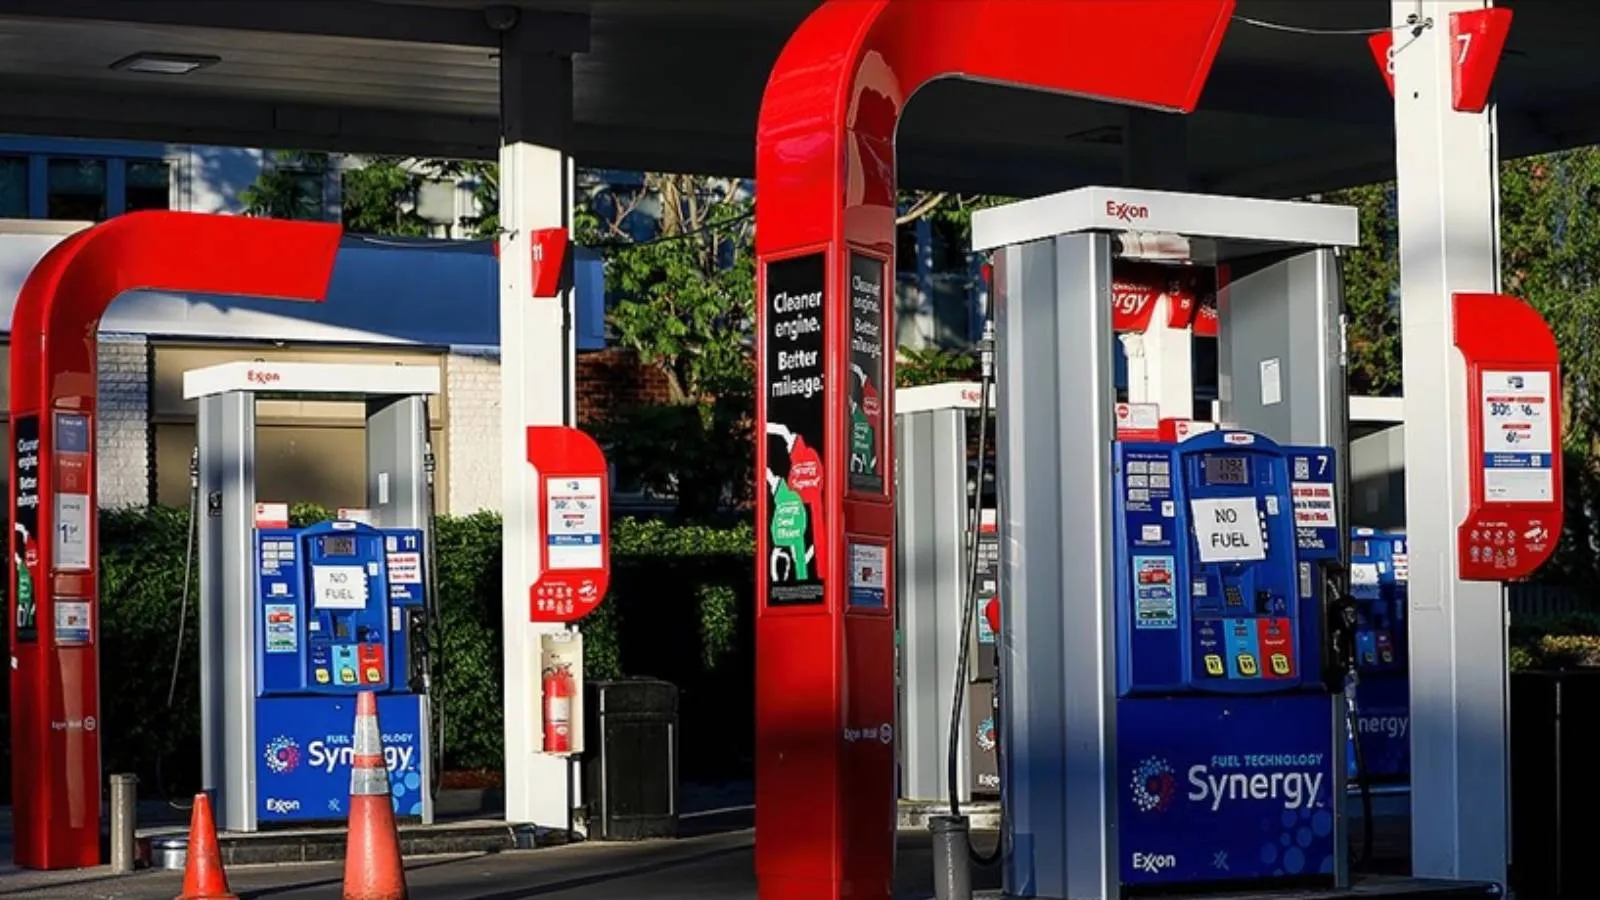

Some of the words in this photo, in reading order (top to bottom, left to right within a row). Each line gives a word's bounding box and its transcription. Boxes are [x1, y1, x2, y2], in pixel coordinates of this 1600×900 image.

[1457, 33, 1472, 64] 7
[1106, 200, 1148, 221] Exxon
[533, 243, 542, 261] 11
[774, 291, 822, 314] Cleaner
[775, 313, 821, 341] engine.
[777, 349, 818, 371] Better
[247, 369, 280, 385] Exxon
[1317, 455, 1328, 475] 7
[1214, 508, 1237, 524] NO
[404, 536, 416, 549] 11
[1212, 532, 1250, 549] FUEL
[329, 572, 348, 584] NO
[325, 588, 356, 600] FUEL
[326, 735, 350, 744] FUEL
[308, 741, 413, 773] Syngy
[1211, 755, 1241, 767] FUEL
[1244, 754, 1323, 766] TECHNOLOGY
[1188, 765, 1323, 811] Synergy
[267, 798, 300, 814] Exxon
[1132, 852, 1176, 874] Exxon
